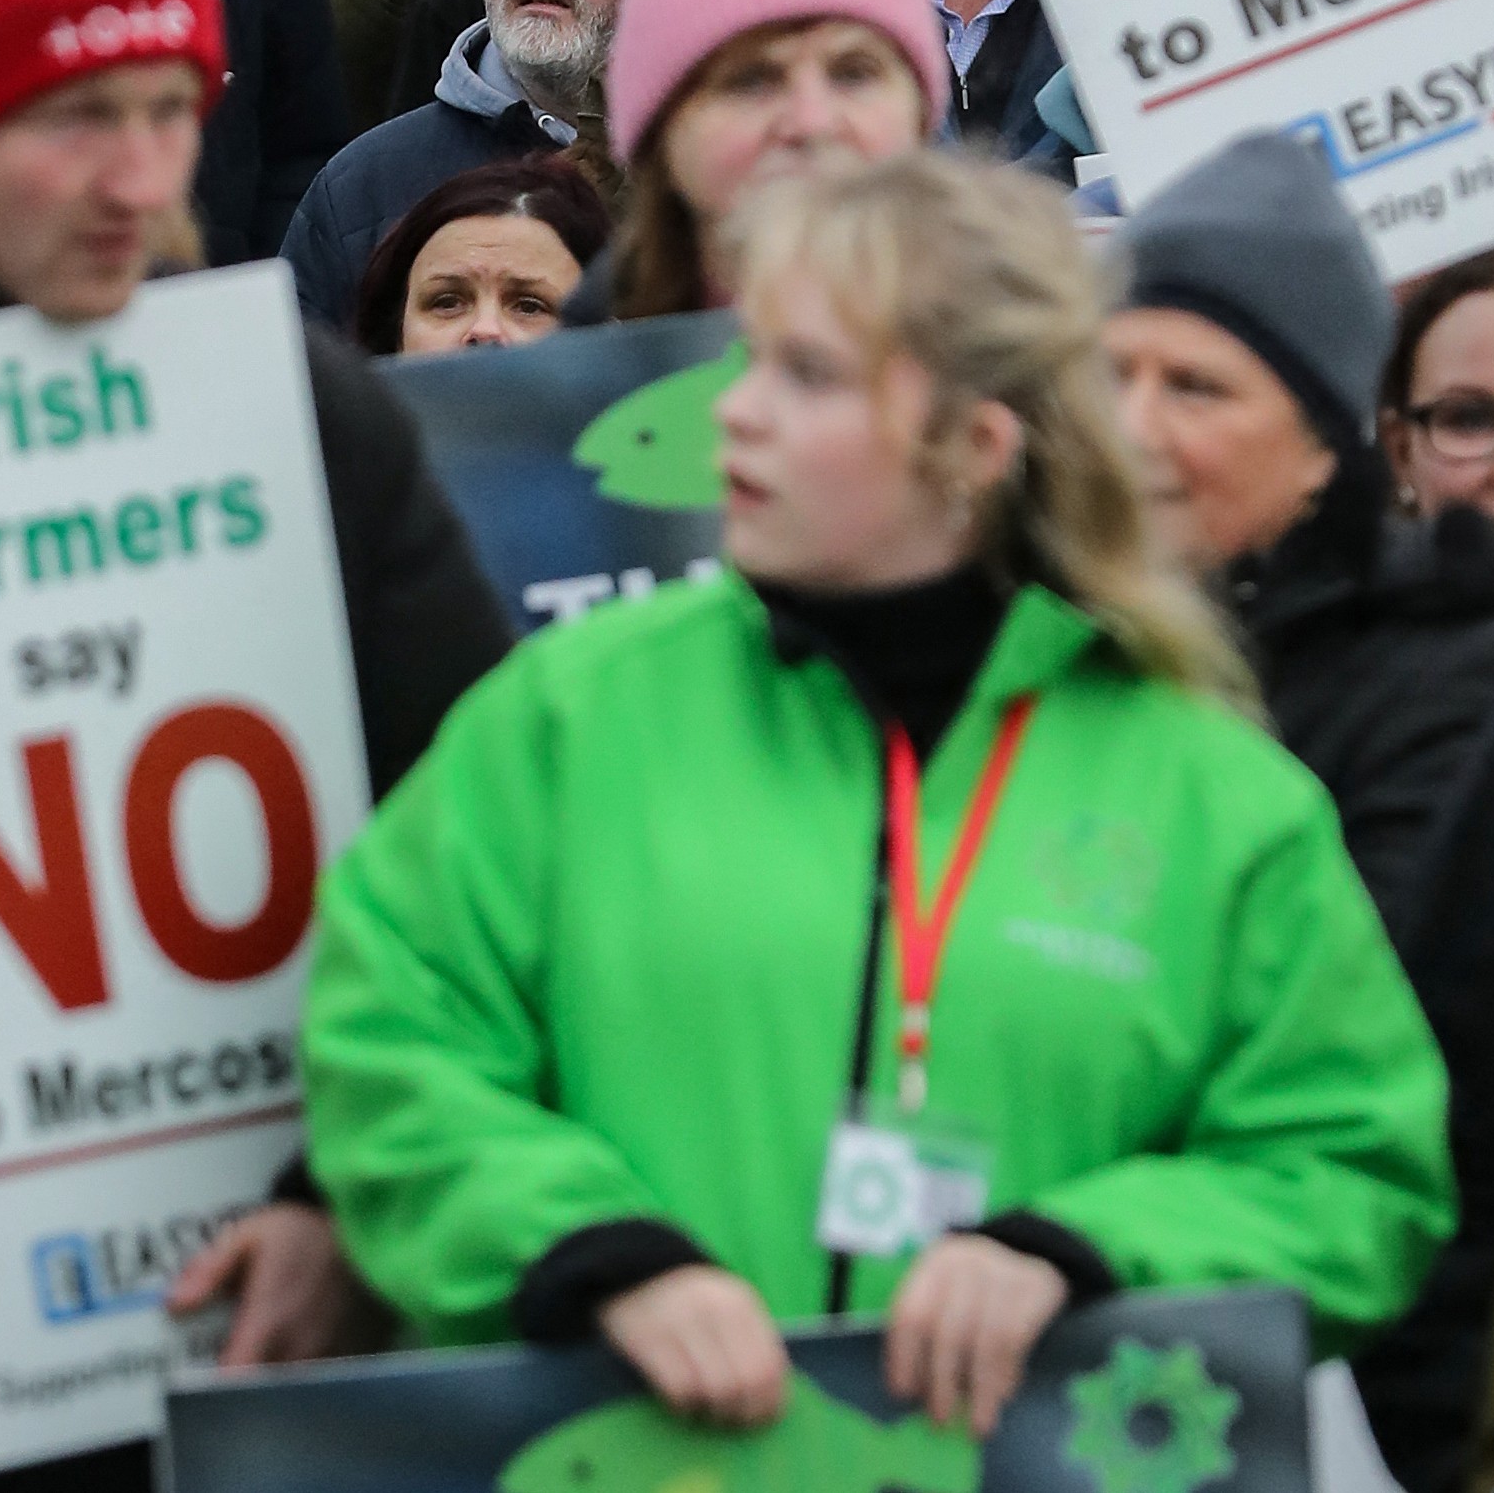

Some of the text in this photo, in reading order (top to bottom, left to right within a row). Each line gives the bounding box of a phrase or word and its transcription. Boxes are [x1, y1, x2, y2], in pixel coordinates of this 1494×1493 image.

[1119, 15, 1209, 82] to
[1362, 182, 1447, 231] ting
[16, 622, 141, 697] say
[23, 1032, 301, 1129] Mercos
